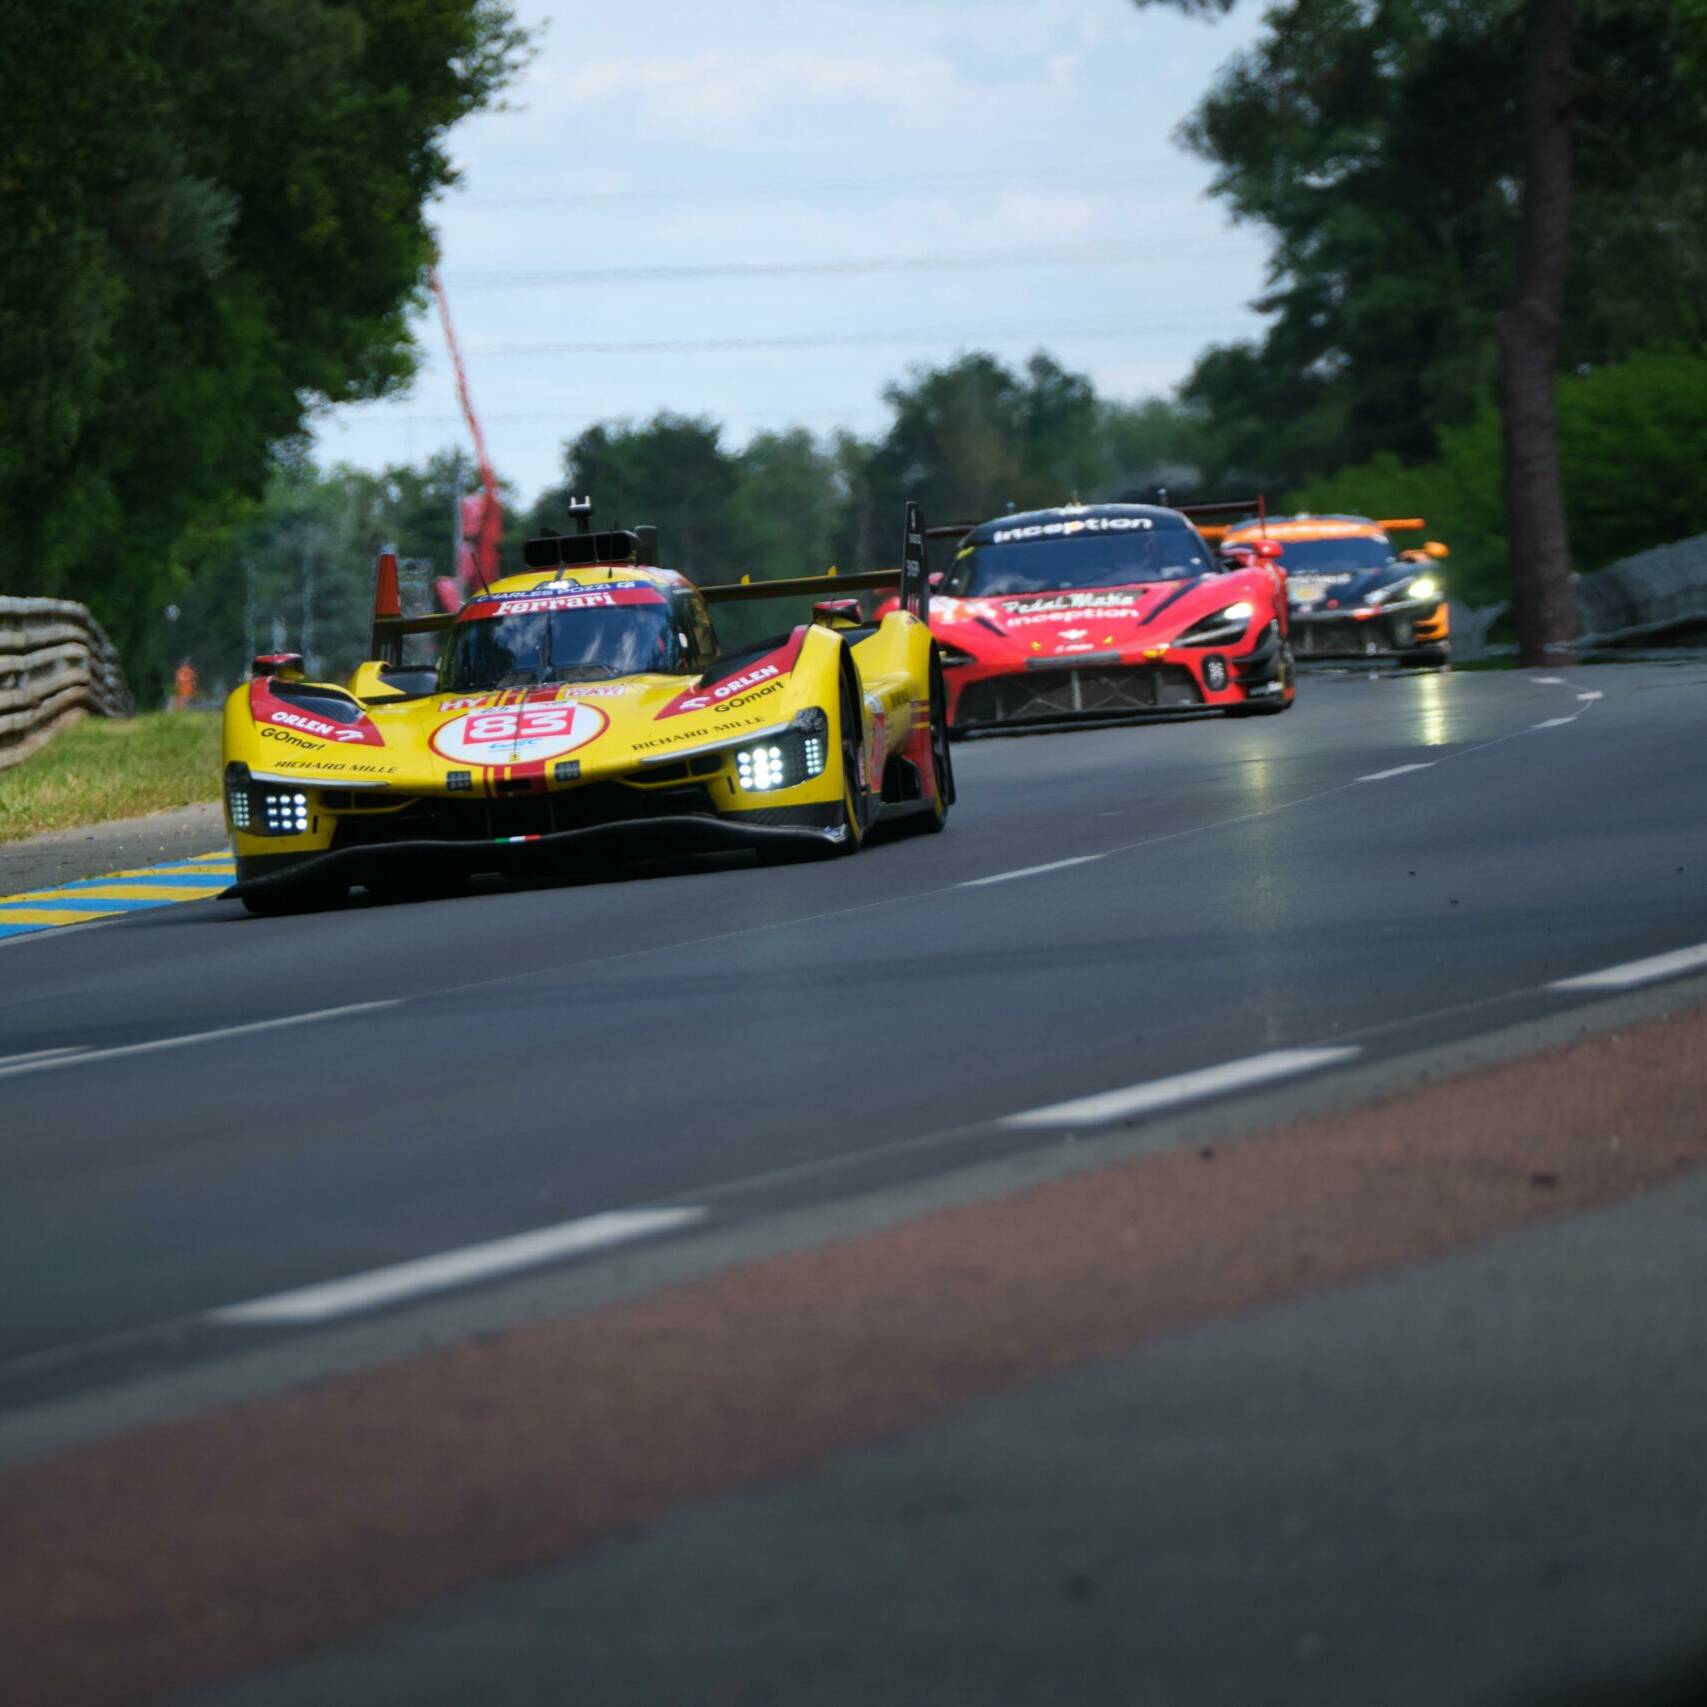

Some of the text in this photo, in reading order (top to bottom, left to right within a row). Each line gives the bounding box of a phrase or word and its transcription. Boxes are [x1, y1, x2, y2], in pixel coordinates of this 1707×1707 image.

[492, 592, 617, 616] Ferrari
[714, 665, 779, 697] ORLEN
[714, 681, 785, 713] GOmart
[271, 711, 335, 735] ORLEN
[469, 709, 569, 740] 83
[632, 716, 766, 751] RICHARD MILLE
[260, 727, 326, 751] GOmart
[274, 760, 398, 774] RICHARD MILLE
